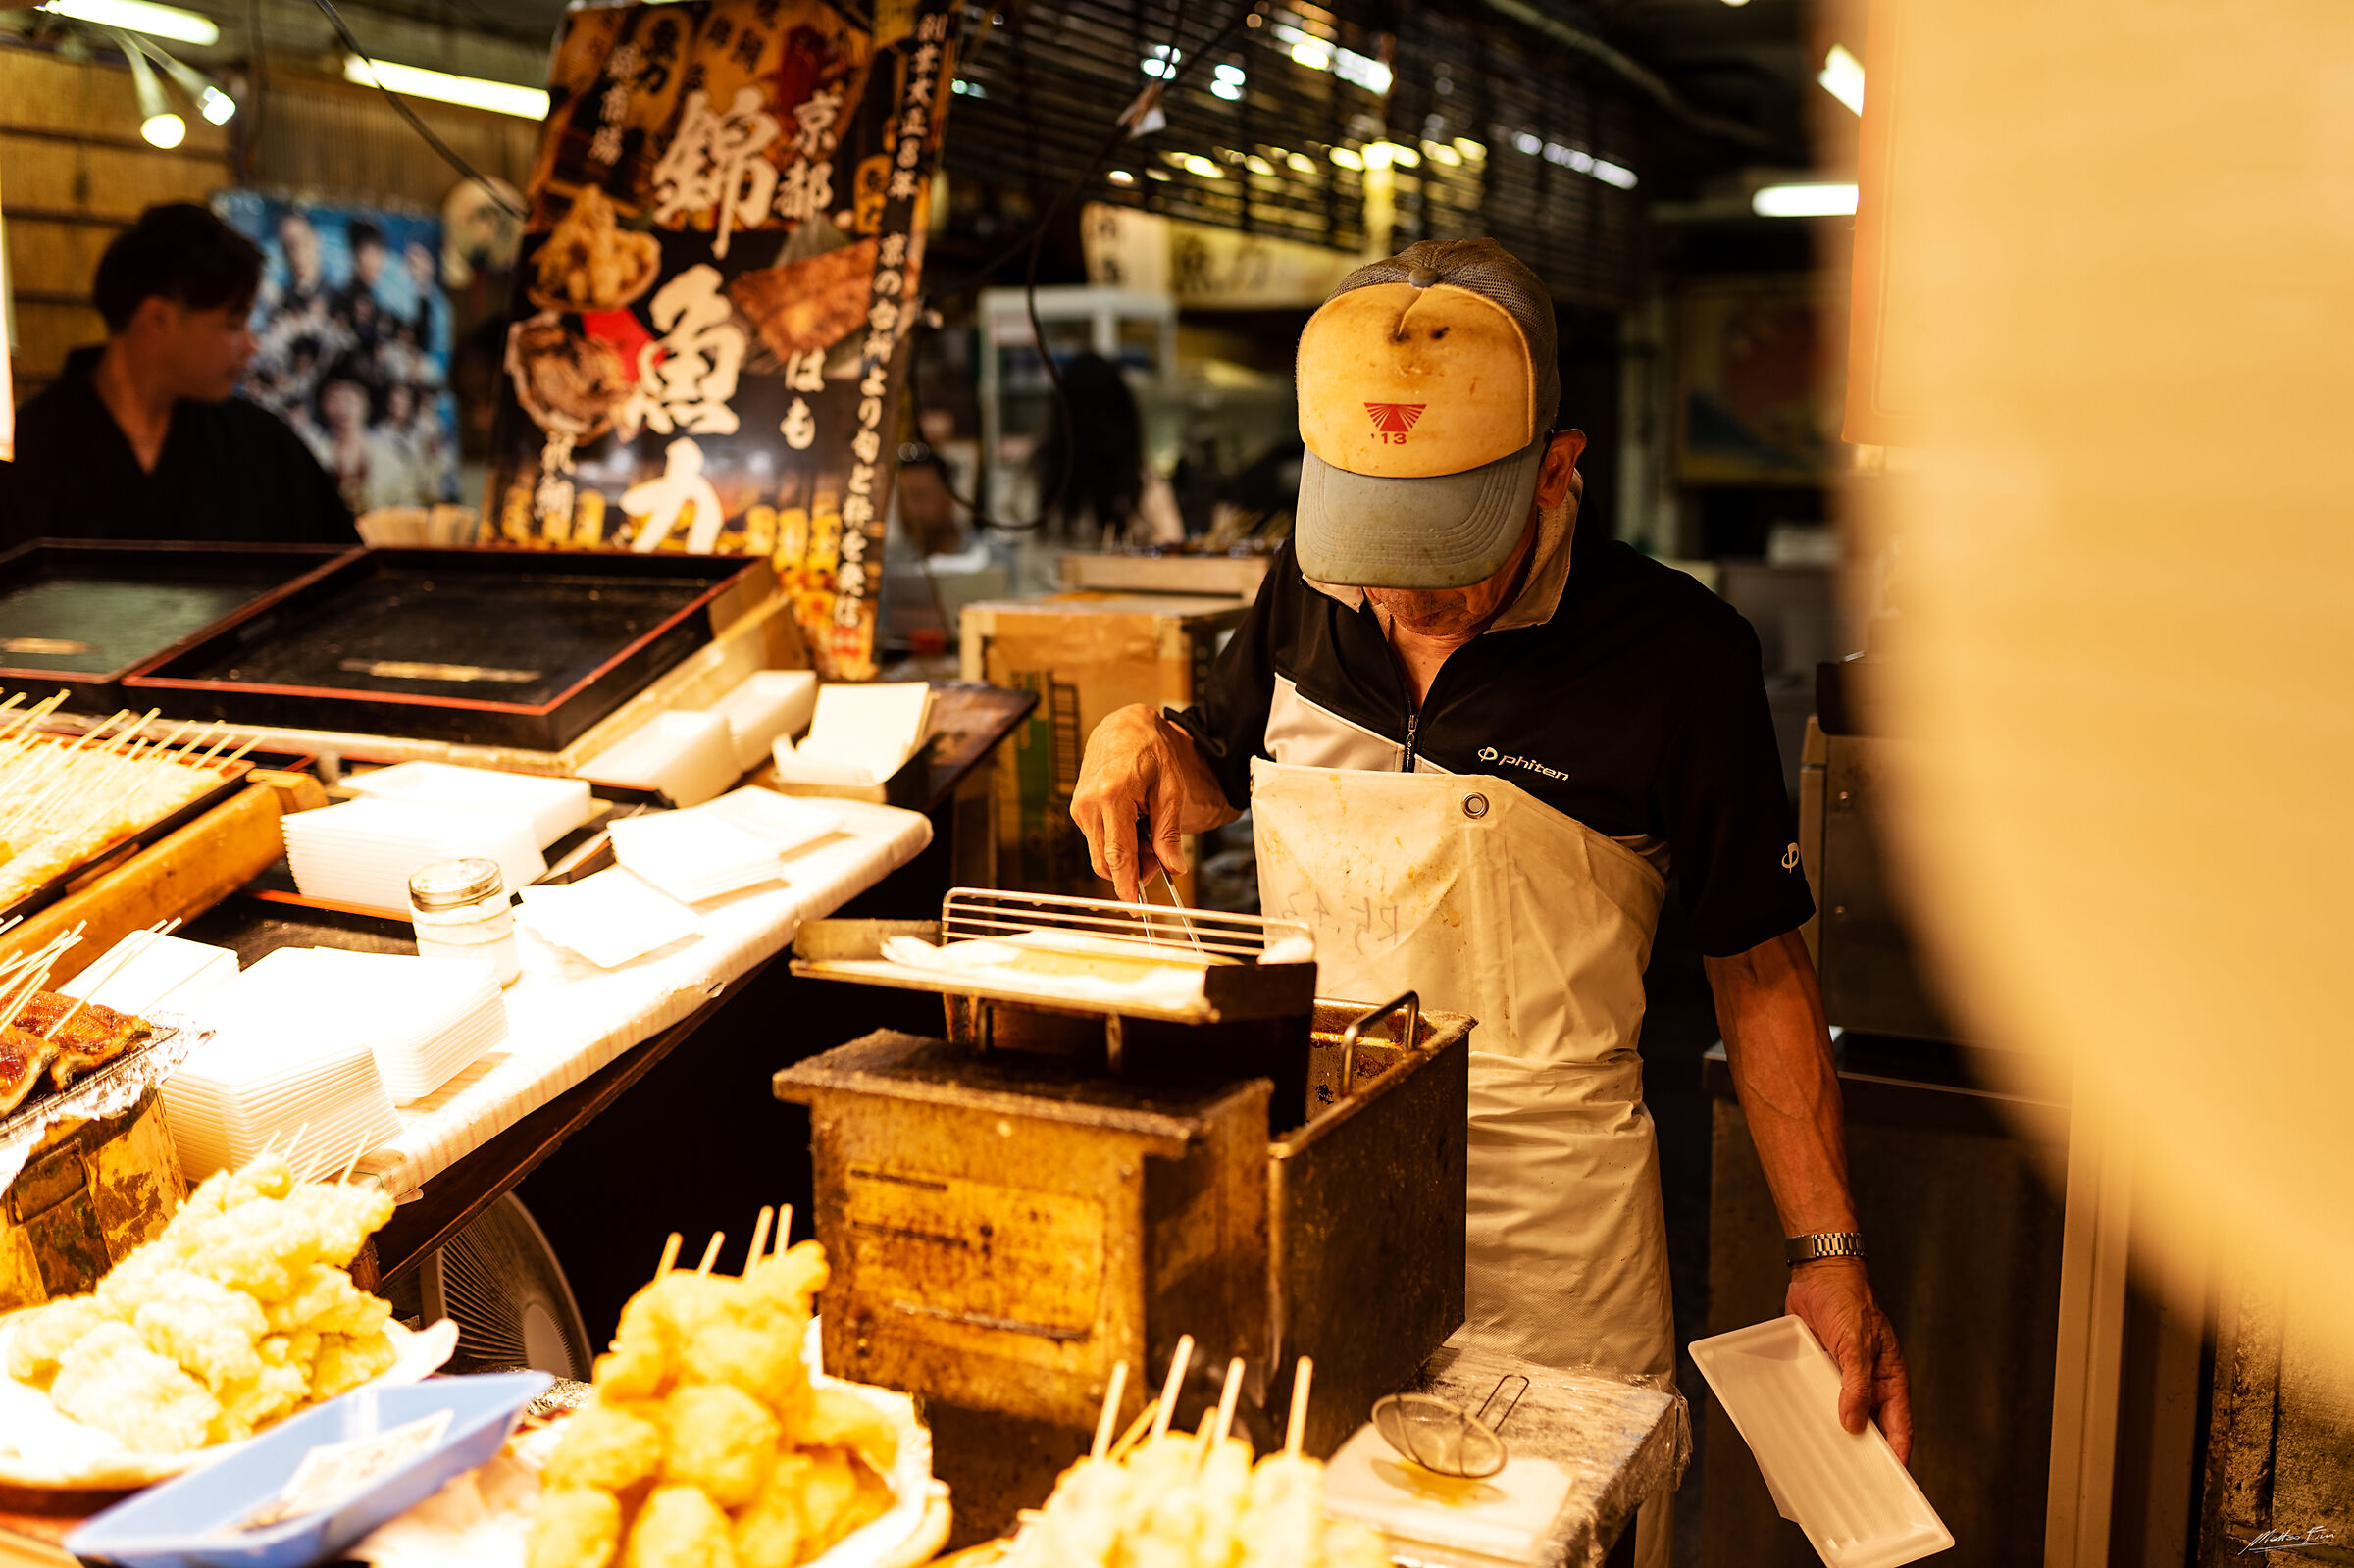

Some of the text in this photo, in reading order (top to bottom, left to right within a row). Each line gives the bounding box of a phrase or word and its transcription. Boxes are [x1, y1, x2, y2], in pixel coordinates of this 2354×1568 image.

[772, 89, 844, 219] 京都
[780, 347, 825, 450] はも
[1498, 754, 1569, 782] phiten
